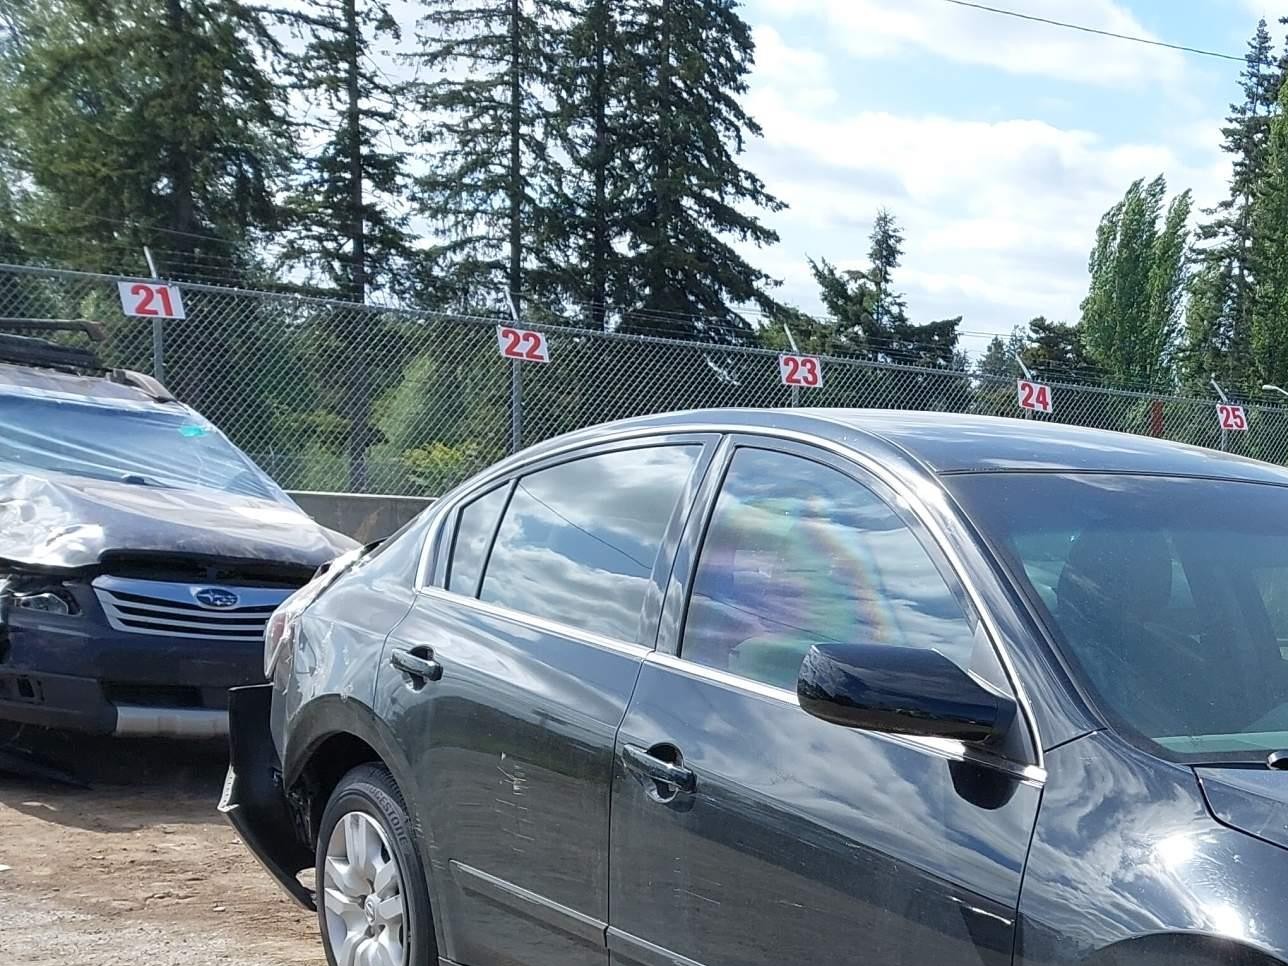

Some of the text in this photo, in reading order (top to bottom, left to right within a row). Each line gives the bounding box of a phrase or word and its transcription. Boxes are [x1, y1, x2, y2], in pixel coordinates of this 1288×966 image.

[130, 284, 174, 317] 21
[501, 329, 545, 361] 22
[783, 357, 819, 386] 23
[1020, 382, 1050, 411] 24
[1219, 406, 1245, 429] 25
